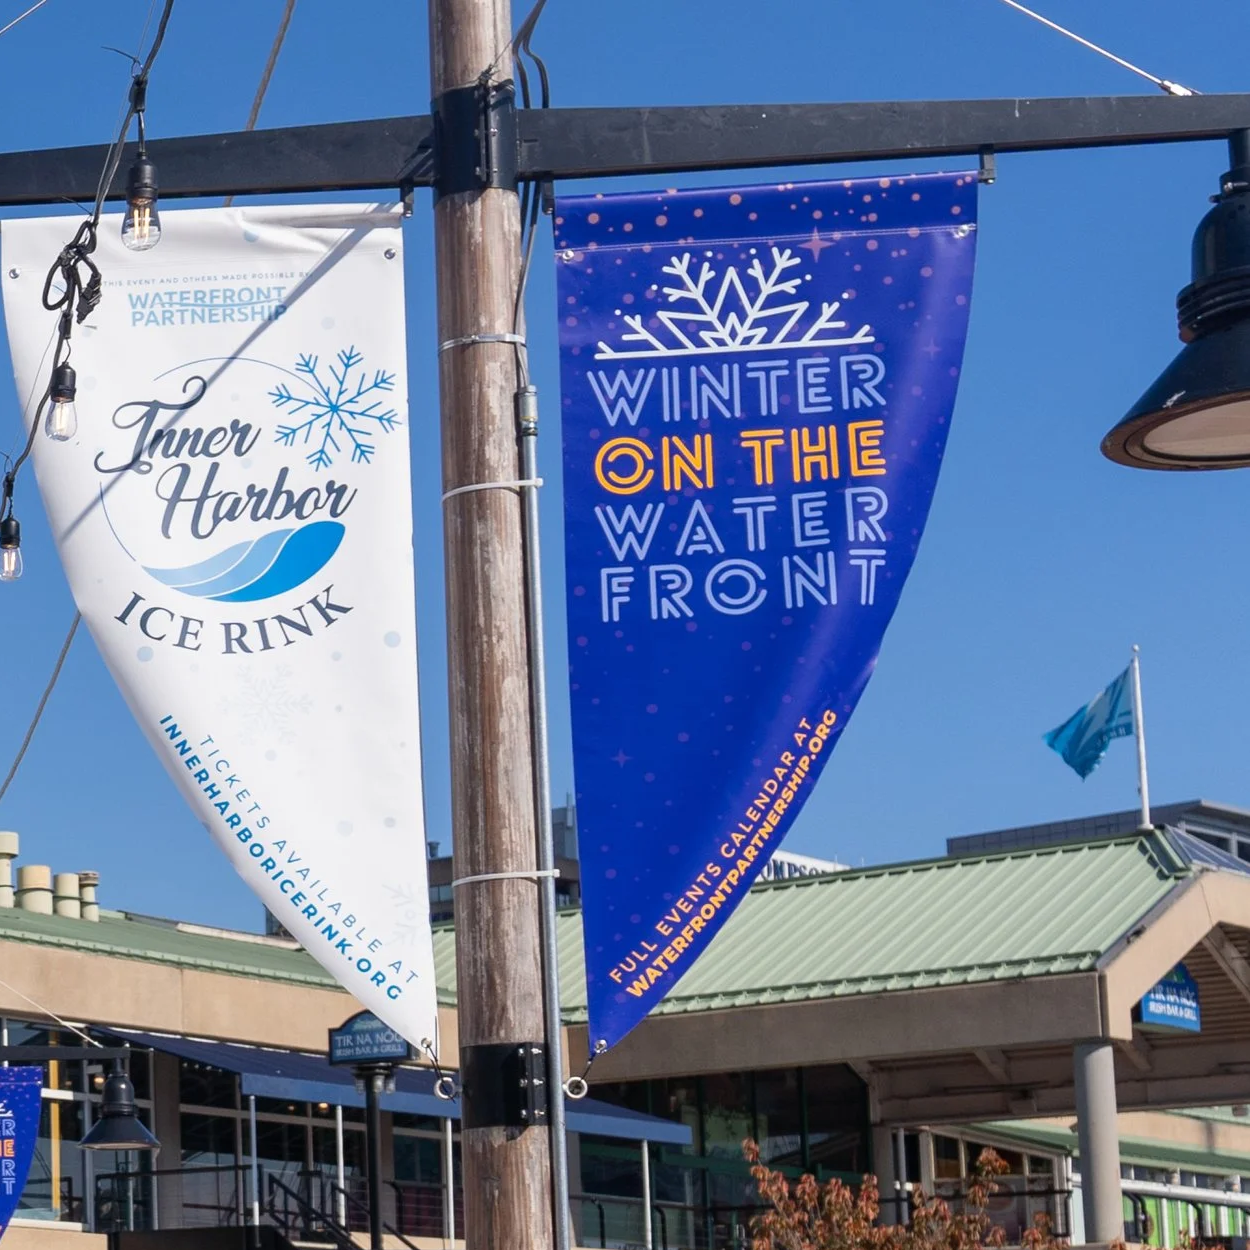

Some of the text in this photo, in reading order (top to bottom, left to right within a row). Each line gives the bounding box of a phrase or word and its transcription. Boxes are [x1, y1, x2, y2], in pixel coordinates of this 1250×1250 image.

[126, 278, 156, 286] EVENT
[159, 276, 178, 284] AND
[182, 275, 218, 283] OTHERS
[222, 274, 248, 282] MADE
[251, 272, 295, 280] POSSIBLE
[128, 286, 287, 310] WATERFRONT
[131, 304, 288, 328] PARTNERSHIP
[94, 376, 262, 474] Inner
[586, 353, 887, 428] WINTER
[594, 419, 887, 496] ON THE
[156, 462, 358, 540] Harbor
[594, 485, 889, 562] WATER
[114, 584, 354, 655] ICE RINK
[600, 548, 887, 623] FRONT
[159, 714, 402, 1001] INNERHARBORICERINK.ORG
[200, 734, 419, 984] TICKETS AVAILABLE AT
[609, 716, 812, 984] FULL EVENTS CALENDAR AT
[625, 708, 837, 998] WATERFRONTPARTNERSHIP.ORG
[334, 1036, 353, 1048] TIR
[356, 1034, 373, 1045] NA
[356, 1046, 371, 1055] BAR
